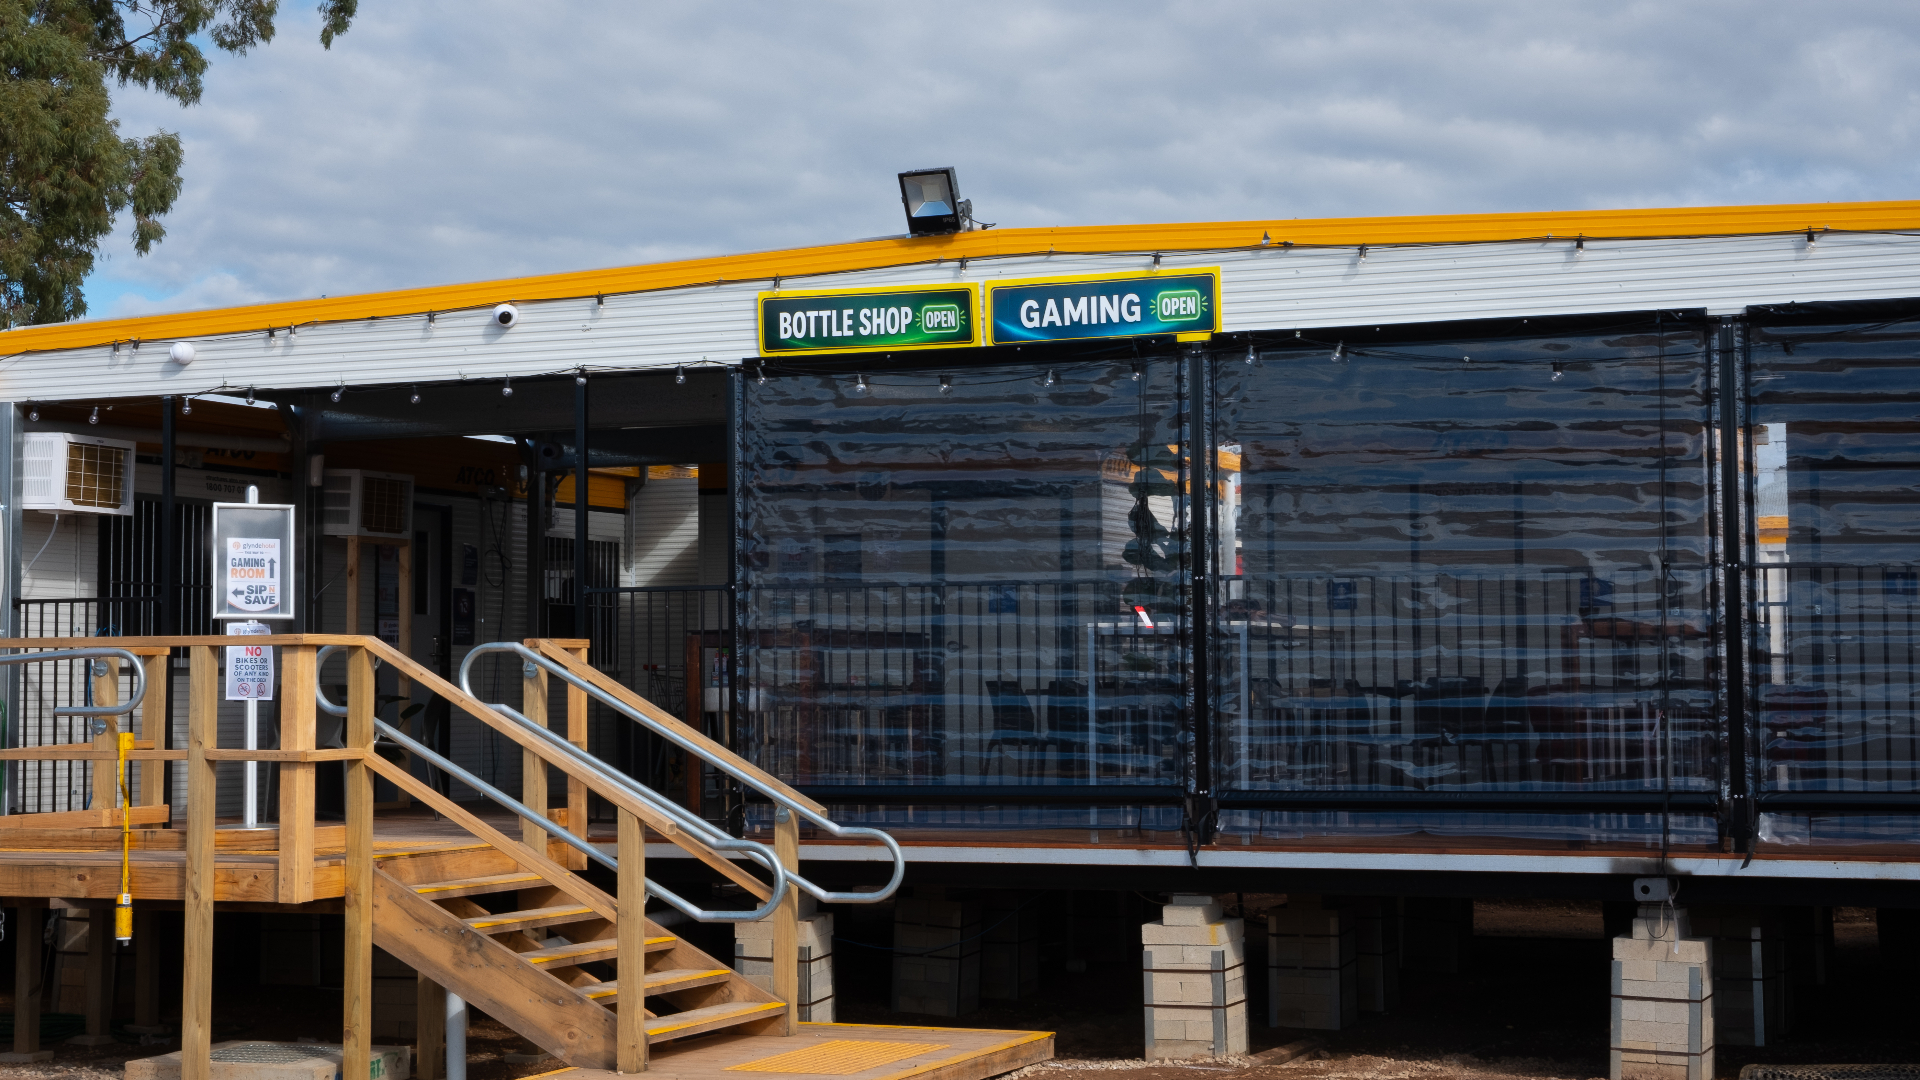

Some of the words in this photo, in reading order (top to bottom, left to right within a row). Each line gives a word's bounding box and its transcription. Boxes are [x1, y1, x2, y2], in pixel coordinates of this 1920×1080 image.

[1020, 293, 1141, 328] GAMING
[1162, 296, 1196, 316] OPEN
[779, 308, 854, 340] BOTTLE
[858, 306, 913, 336] SHOP
[925, 311, 956, 329] OPEN
[455, 466, 495, 485] ATCO
[206, 482, 222, 492] 1800
[224, 484, 236, 493] 707
[231, 557, 266, 568] GAMING
[231, 568, 265, 579] ROOM
[246, 584, 267, 595] SIP
[244, 595, 276, 605] SAVE
[245, 646, 262, 657] NO
